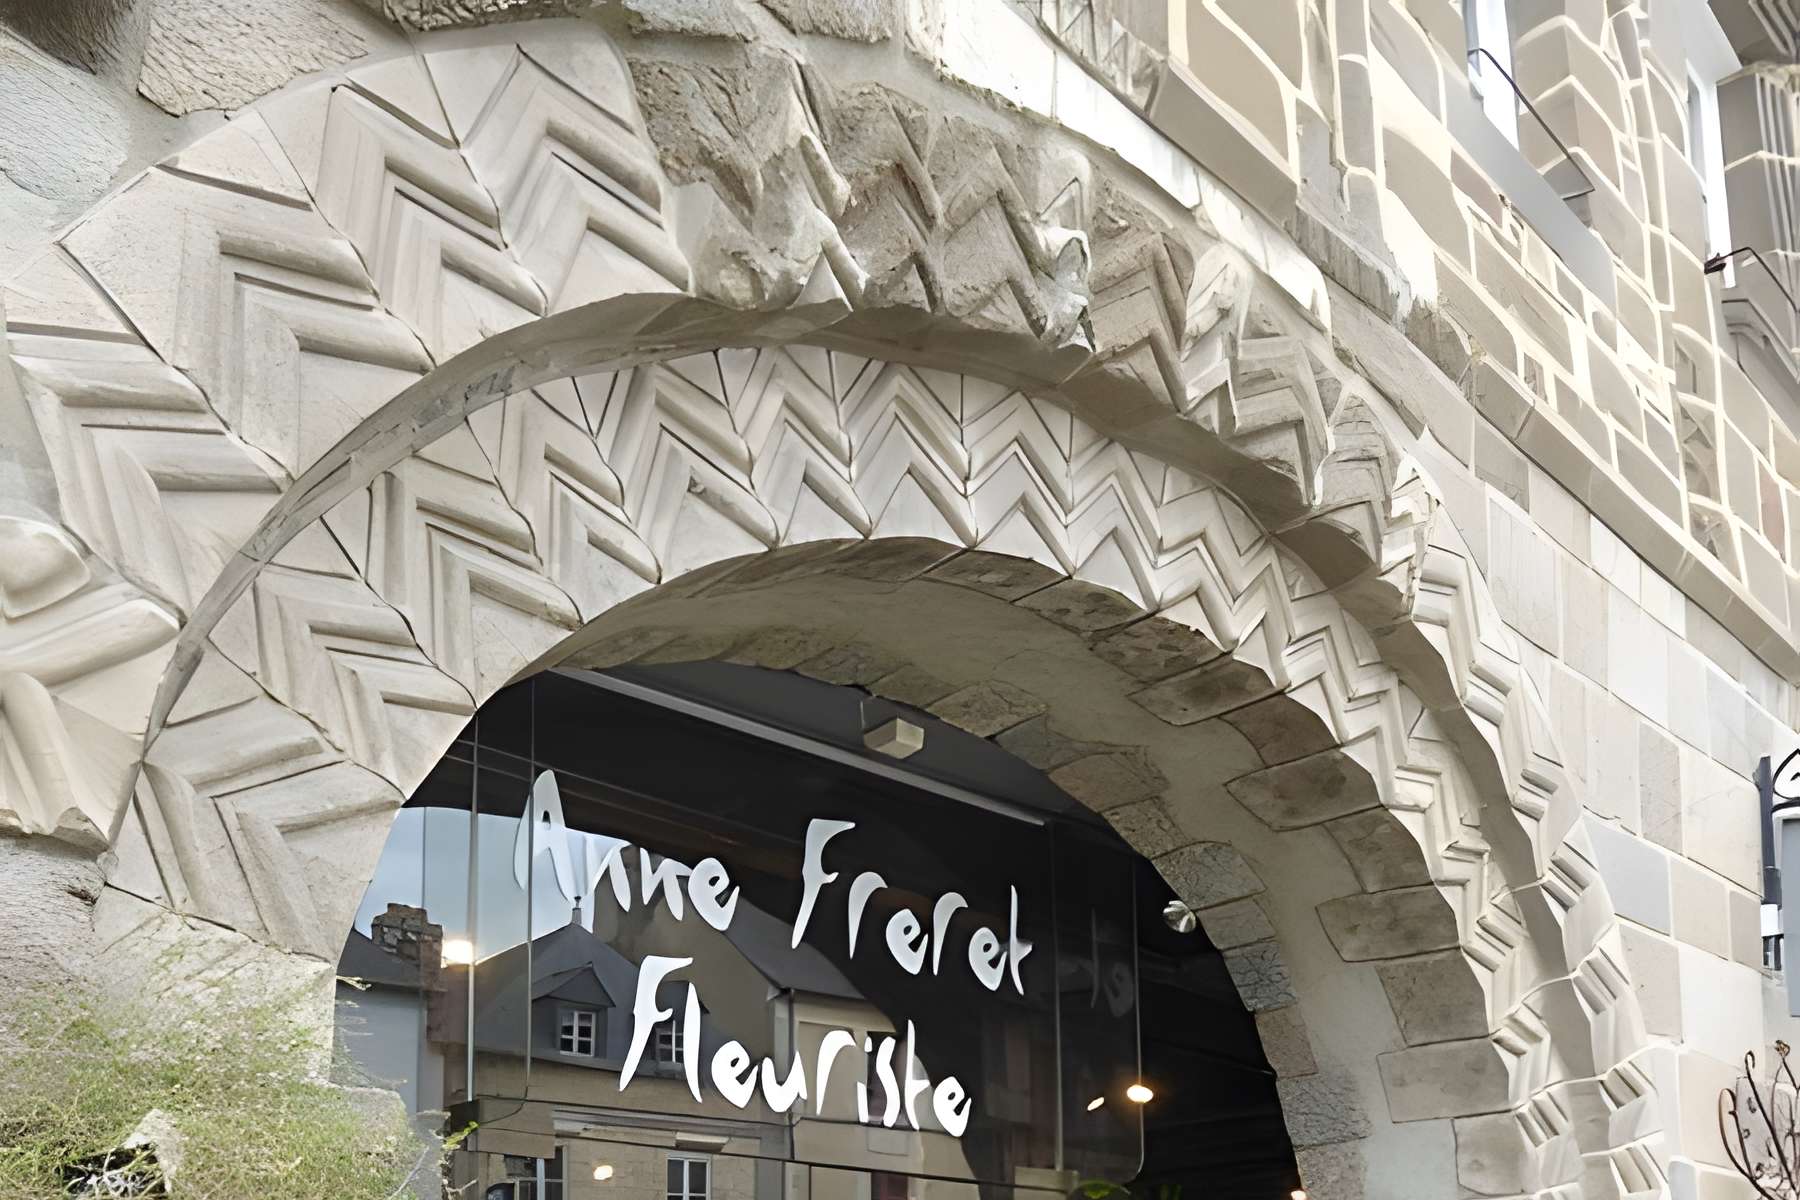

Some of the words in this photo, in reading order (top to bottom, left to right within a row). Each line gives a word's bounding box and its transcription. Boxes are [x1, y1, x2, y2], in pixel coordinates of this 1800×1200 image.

[513, 769, 739, 931] Anne
[791, 818, 1033, 996] Freret
[619, 955, 972, 1138] Fleuriste
